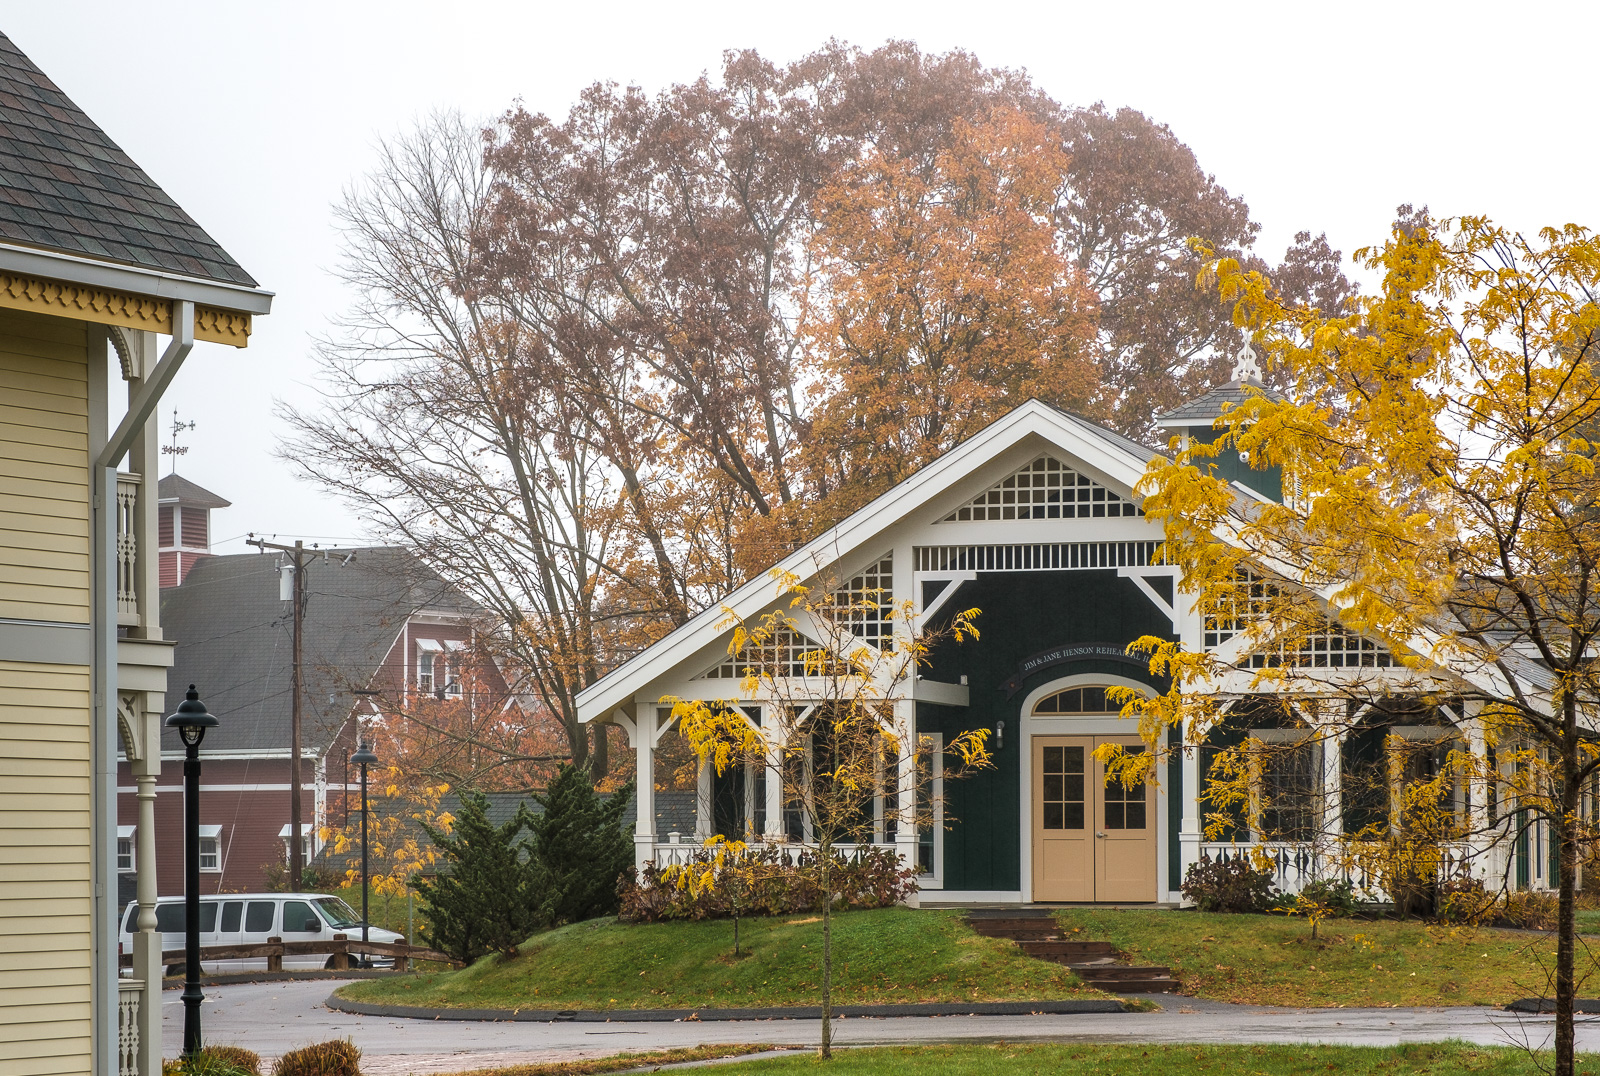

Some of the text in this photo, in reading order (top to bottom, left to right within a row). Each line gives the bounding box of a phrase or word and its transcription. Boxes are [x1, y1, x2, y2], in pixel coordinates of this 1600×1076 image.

[1024, 660, 1037, 671] JIM
[1036, 657, 1044, 665] &
[1043, 651, 1062, 663] JANE
[1063, 646, 1094, 657] HENSON
